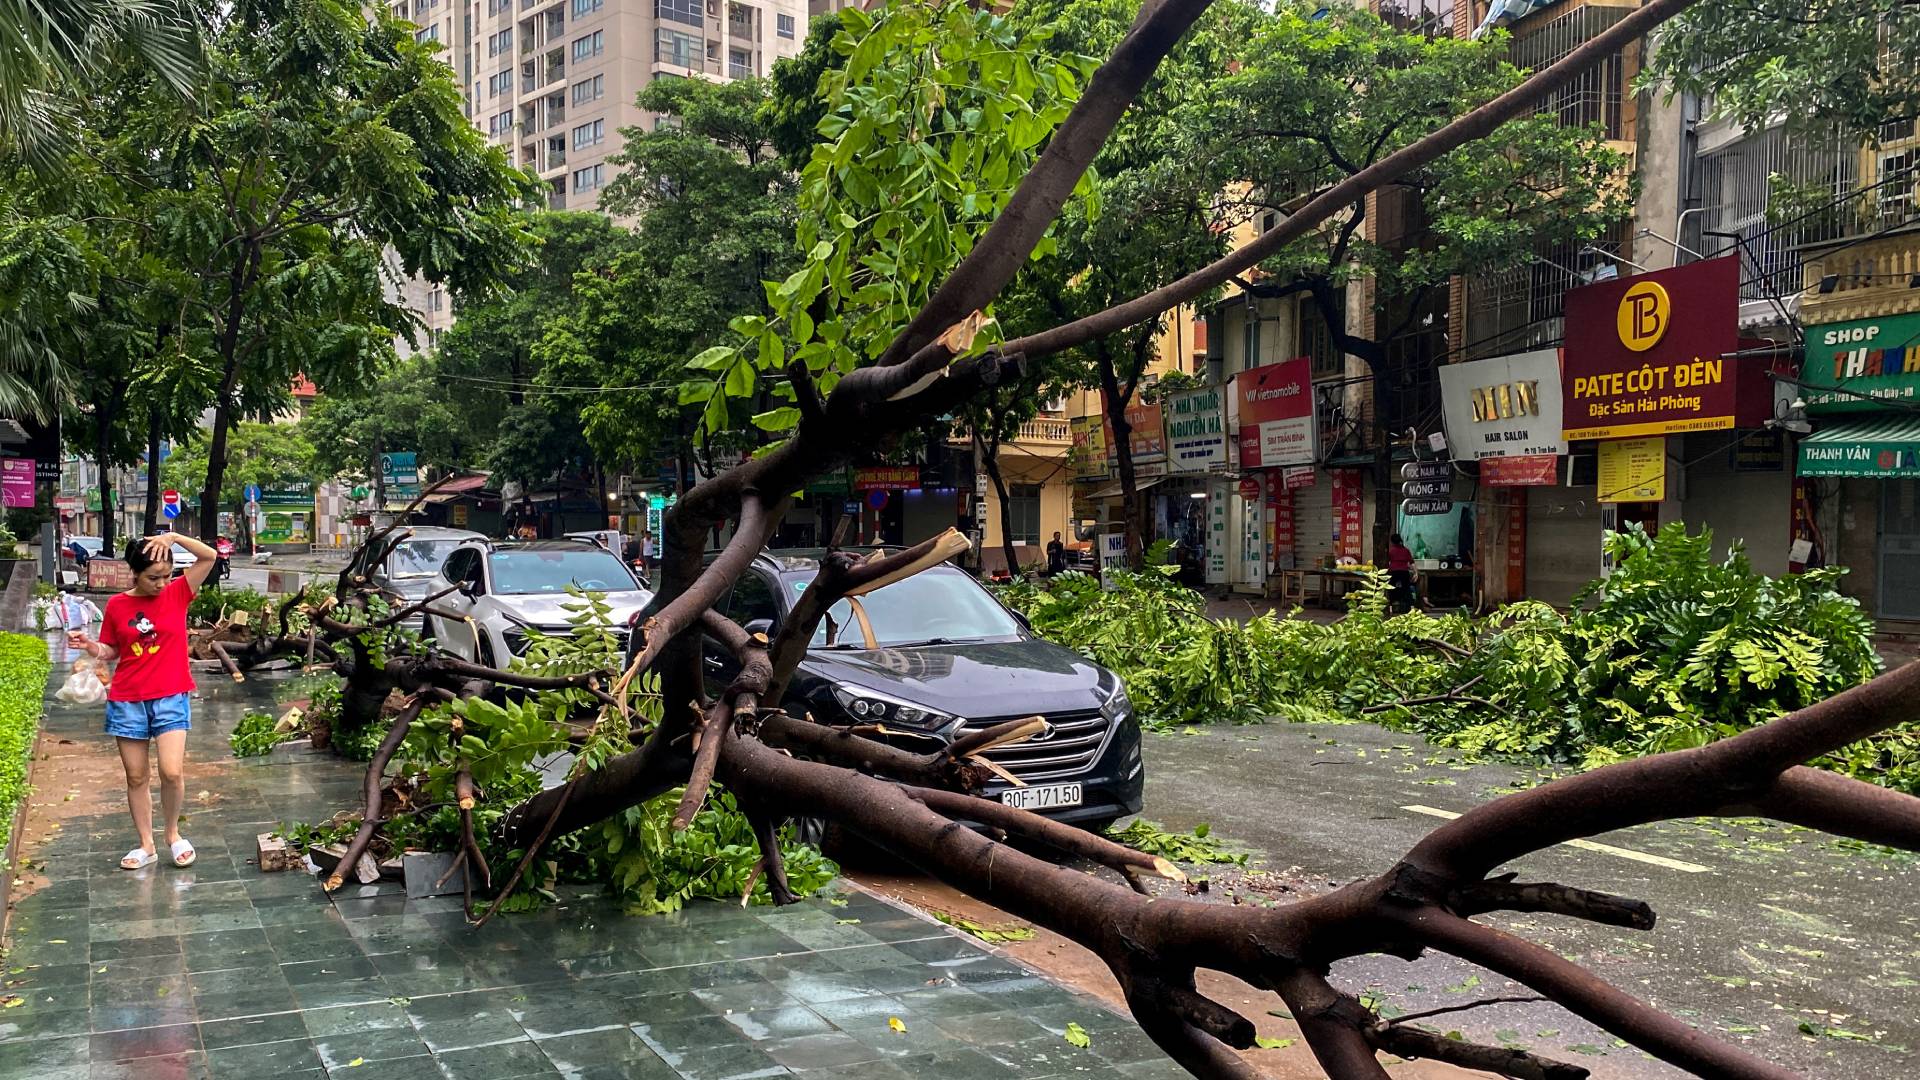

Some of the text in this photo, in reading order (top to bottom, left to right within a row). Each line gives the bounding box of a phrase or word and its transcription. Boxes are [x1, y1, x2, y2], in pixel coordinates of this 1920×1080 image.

[1824, 325, 1879, 345] SHOP
[1574, 356, 1723, 399] PATE CỘT ĐÈN
[1193, 388, 1220, 412] THUỐC
[1258, 382, 1300, 401] vietnamobile
[1471, 379, 1540, 423] MIN
[1589, 401, 1610, 419] Đặc
[1613, 399, 1635, 414] Sản
[1659, 394, 1701, 412] Phòng
[1484, 430, 1529, 443] HAIR SALON
[1805, 444, 1871, 460] THANH VÂN
[1408, 503, 1430, 513] PHUN
[1004, 786, 1080, 808] 30F-171.50
